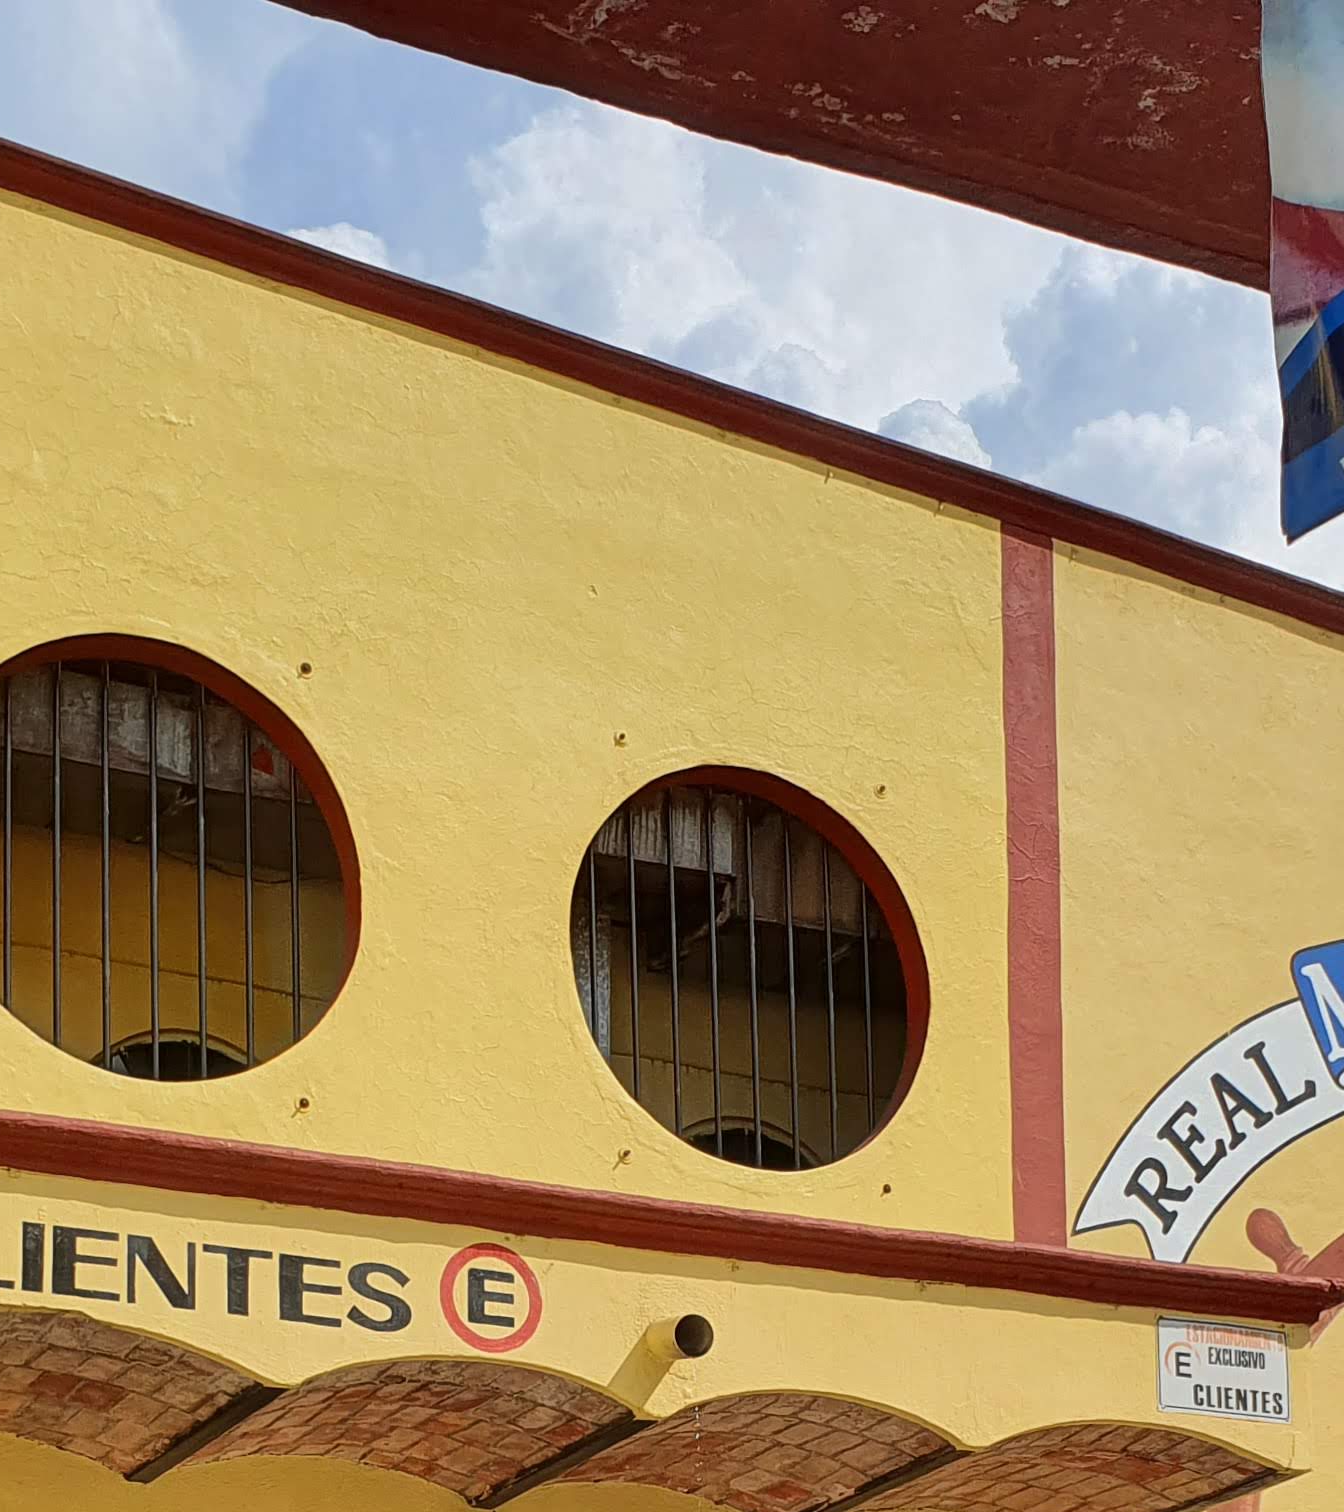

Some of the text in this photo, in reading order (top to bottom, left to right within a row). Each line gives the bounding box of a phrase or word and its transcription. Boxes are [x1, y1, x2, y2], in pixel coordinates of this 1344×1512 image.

[1124, 1041, 1317, 1235] REAL
[466, 1267, 517, 1329] E
[1174, 1346, 1266, 1379] E EXCLUSIVO
[1192, 1383, 1284, 1416] CLIENTES
